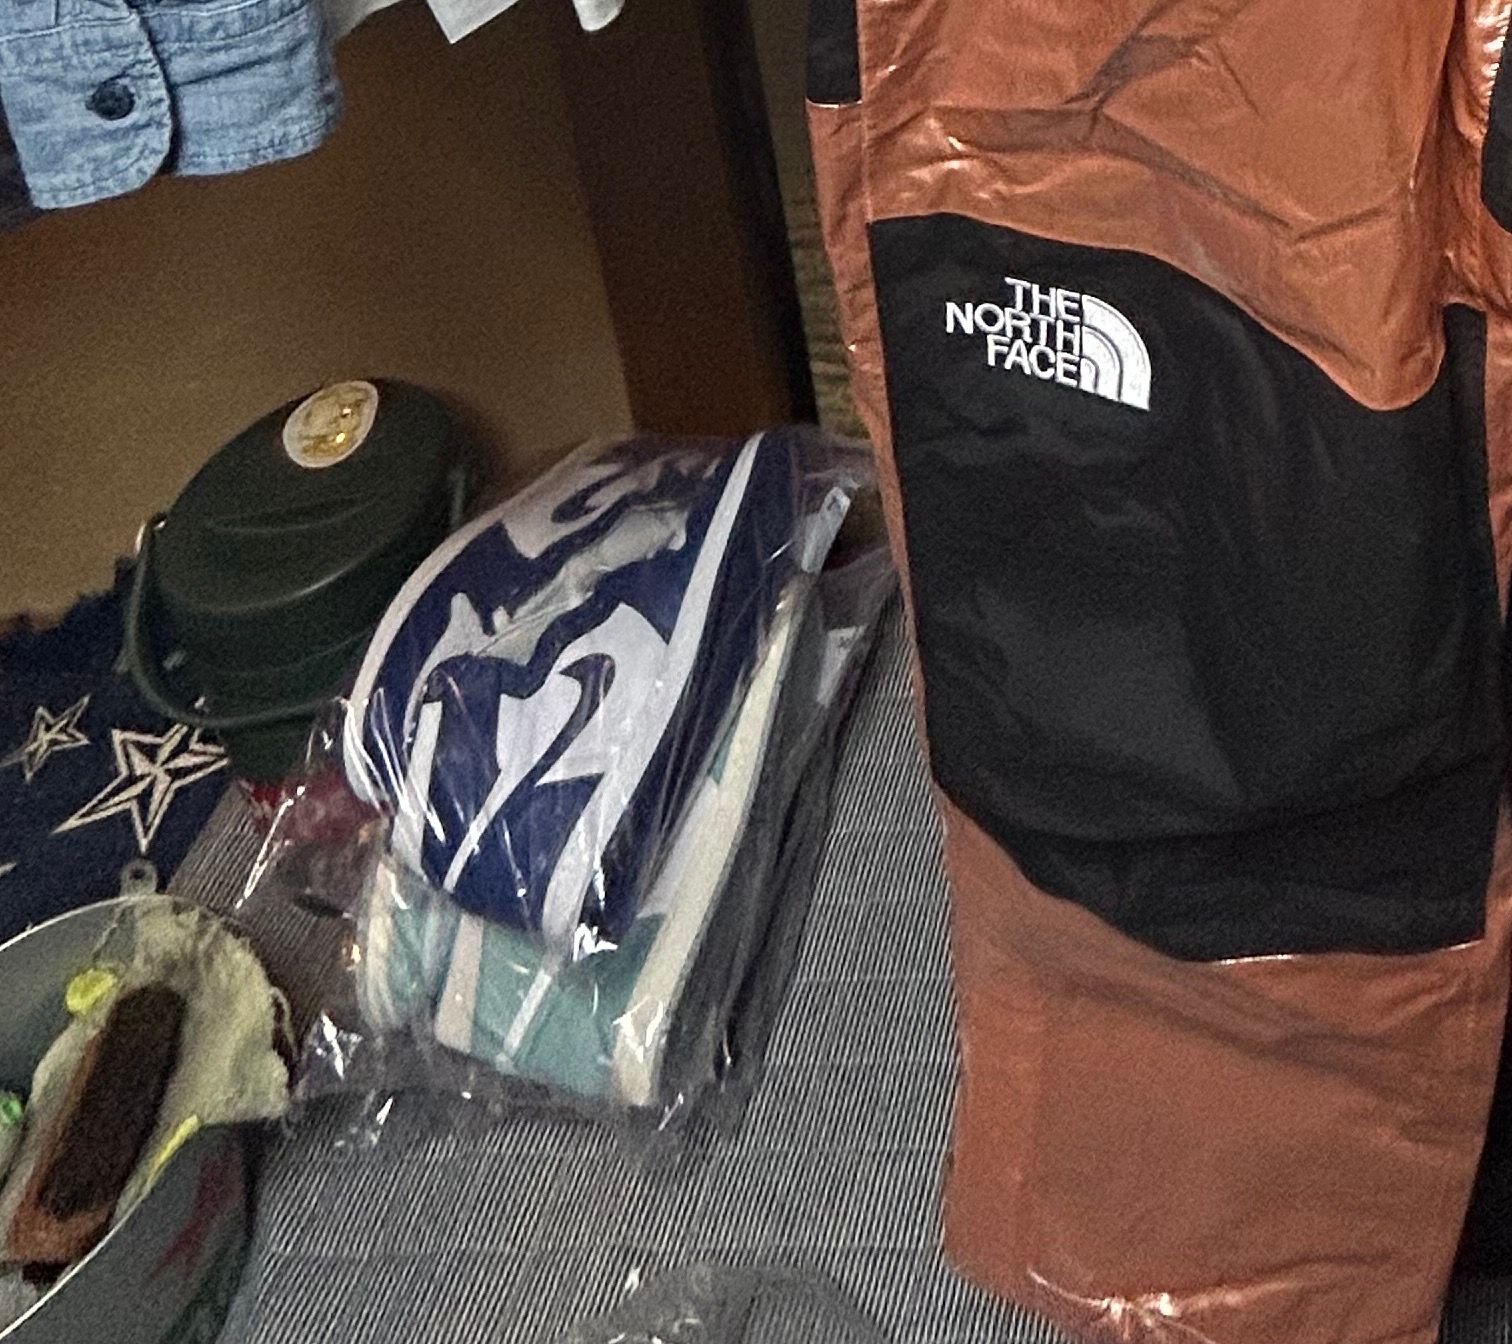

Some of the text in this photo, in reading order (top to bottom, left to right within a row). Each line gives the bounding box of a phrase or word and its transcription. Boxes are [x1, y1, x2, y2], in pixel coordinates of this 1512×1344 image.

[1005, 276, 1081, 322] THE
[946, 302, 1082, 356] NORTH
[987, 334, 1079, 387] FACE
